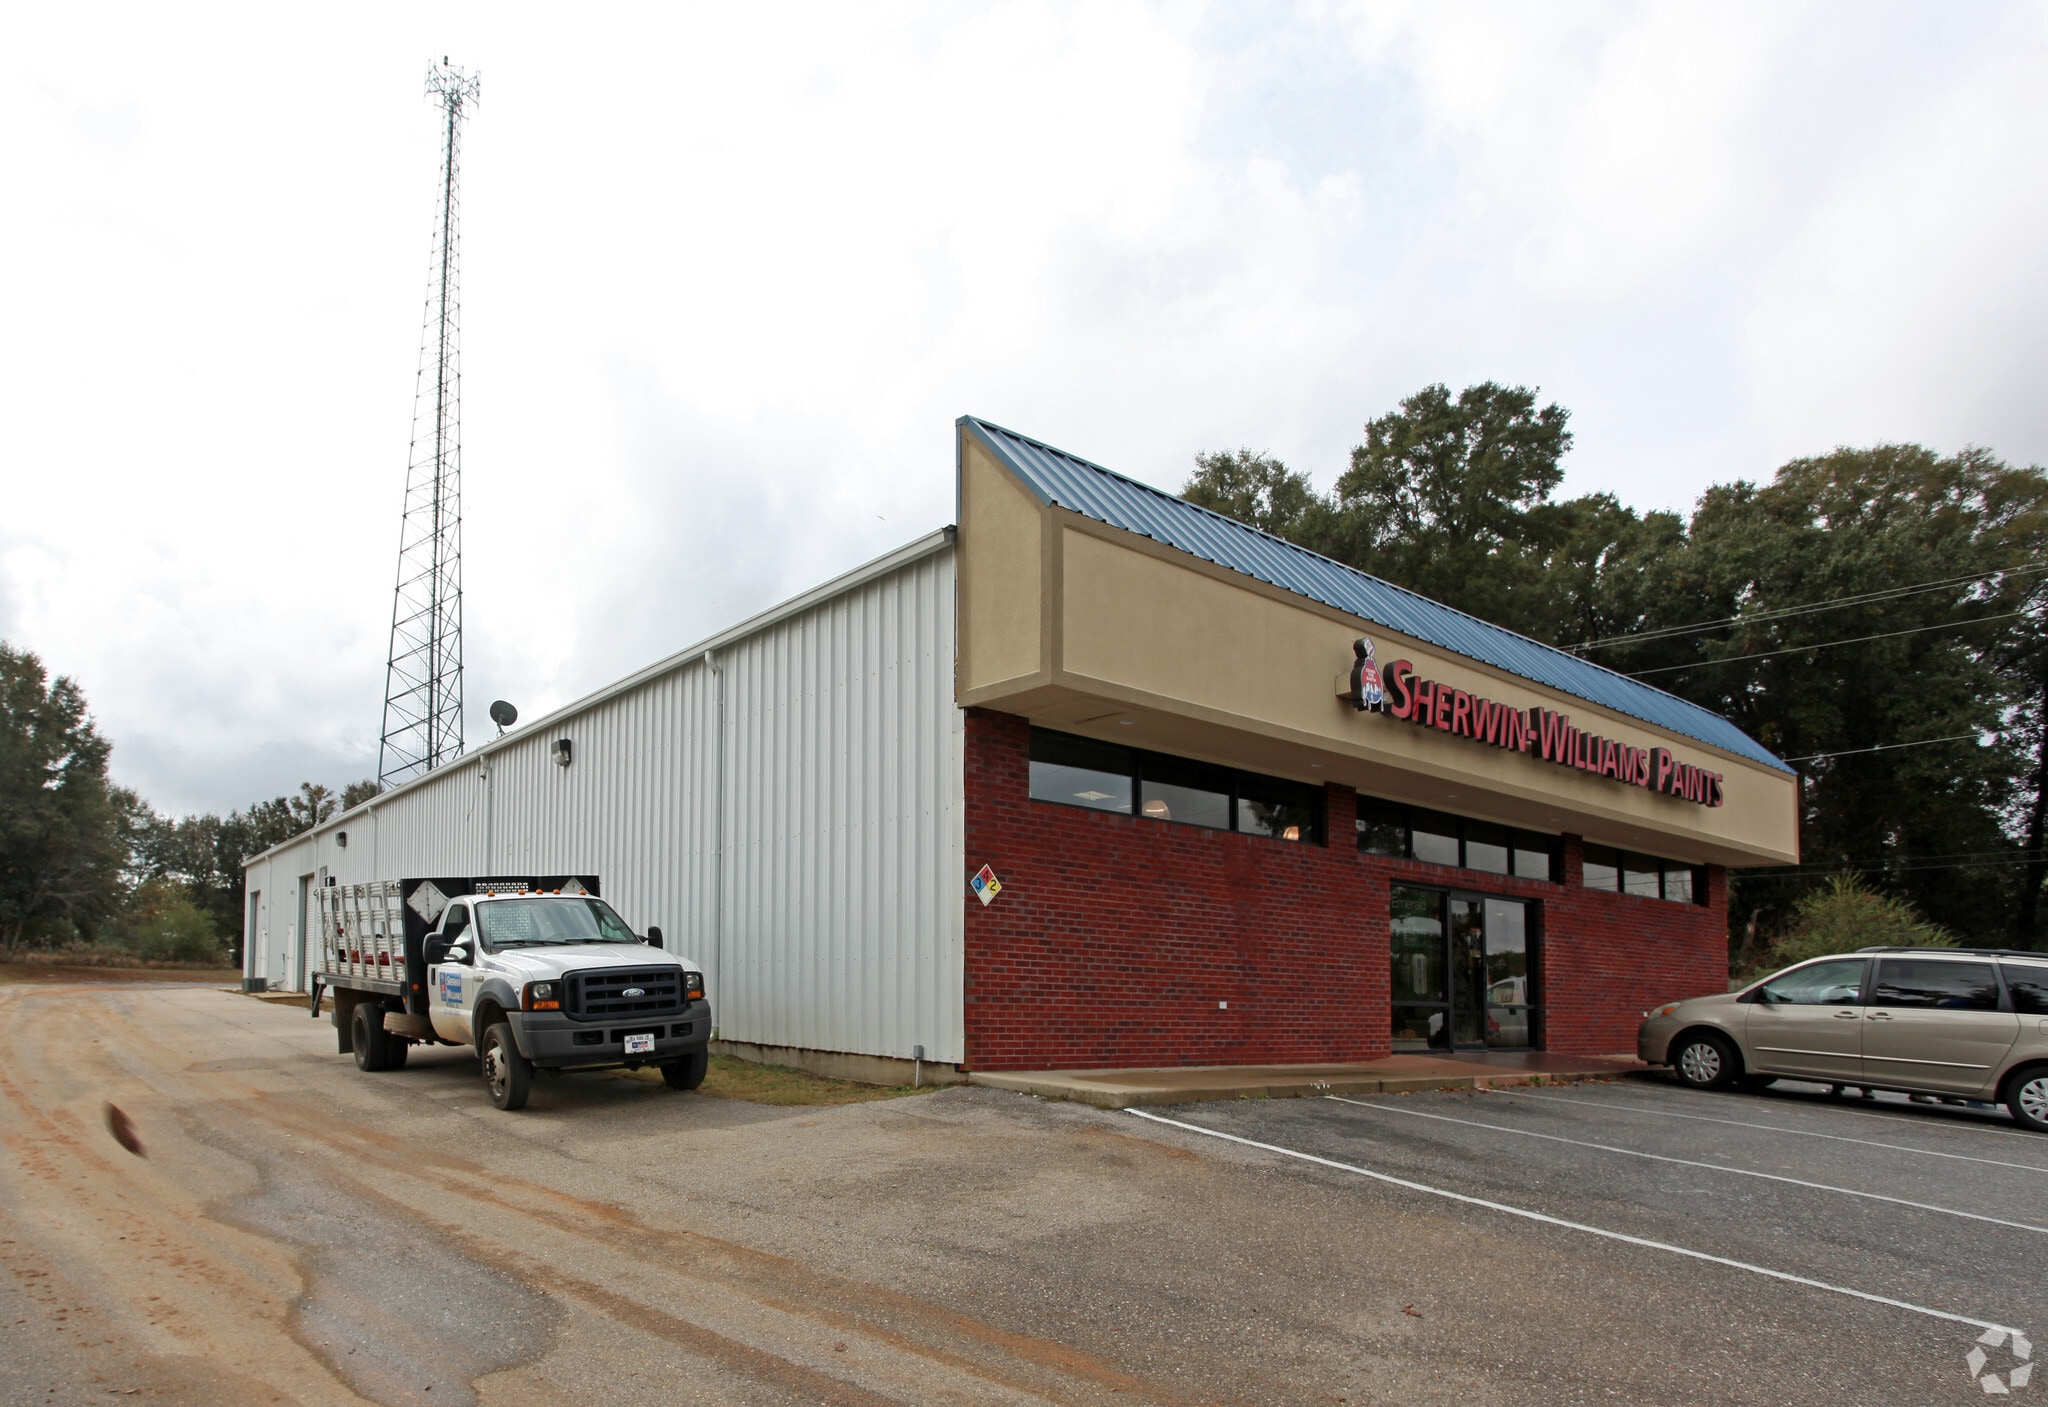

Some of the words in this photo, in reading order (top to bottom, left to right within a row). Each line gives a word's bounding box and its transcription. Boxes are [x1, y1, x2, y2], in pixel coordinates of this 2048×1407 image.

[1387, 659, 1648, 786] SHERWIN-WILLIAMS
[1655, 747, 1723, 807] PAINTS
[983, 870, 989, 881] 4
[975, 878, 982, 890] 3
[990, 879, 997, 891] 2
